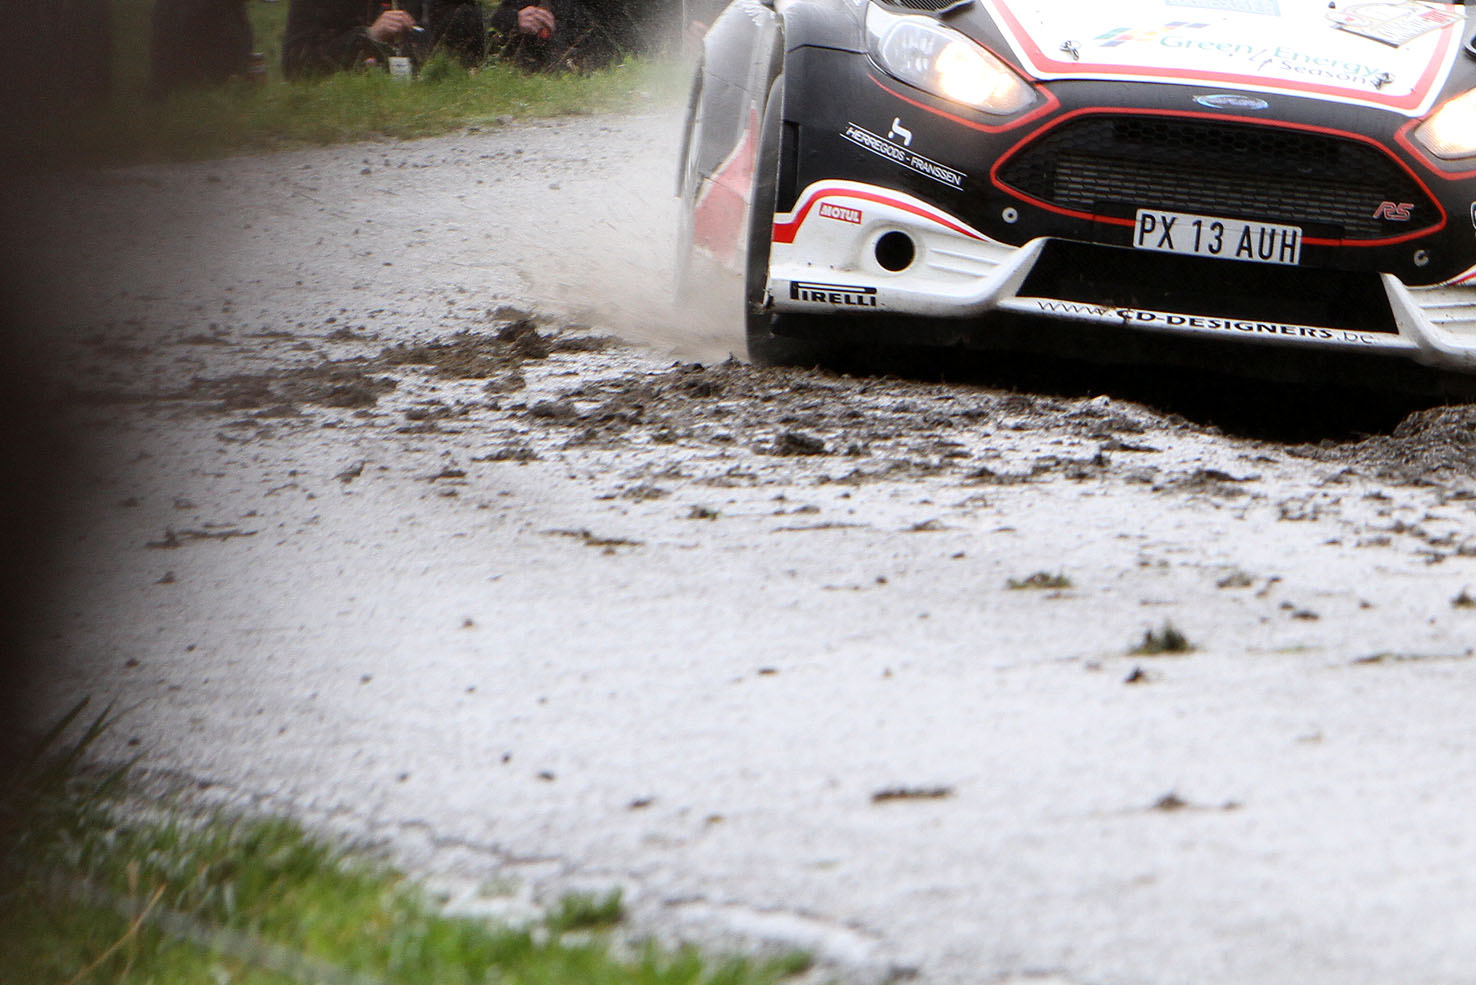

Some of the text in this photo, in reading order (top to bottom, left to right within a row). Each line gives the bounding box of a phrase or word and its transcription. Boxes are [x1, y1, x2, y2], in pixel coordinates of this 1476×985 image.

[1160, 35, 1380, 77] Green Energy
[846, 127, 905, 162] HERREGODS
[910, 156, 962, 186] FRANSSEN
[820, 205, 861, 222] MOTUL
[1373, 201, 1414, 221] RS
[1138, 213, 1298, 264] PX 13 AUH
[789, 280, 877, 306] PIRELLI
